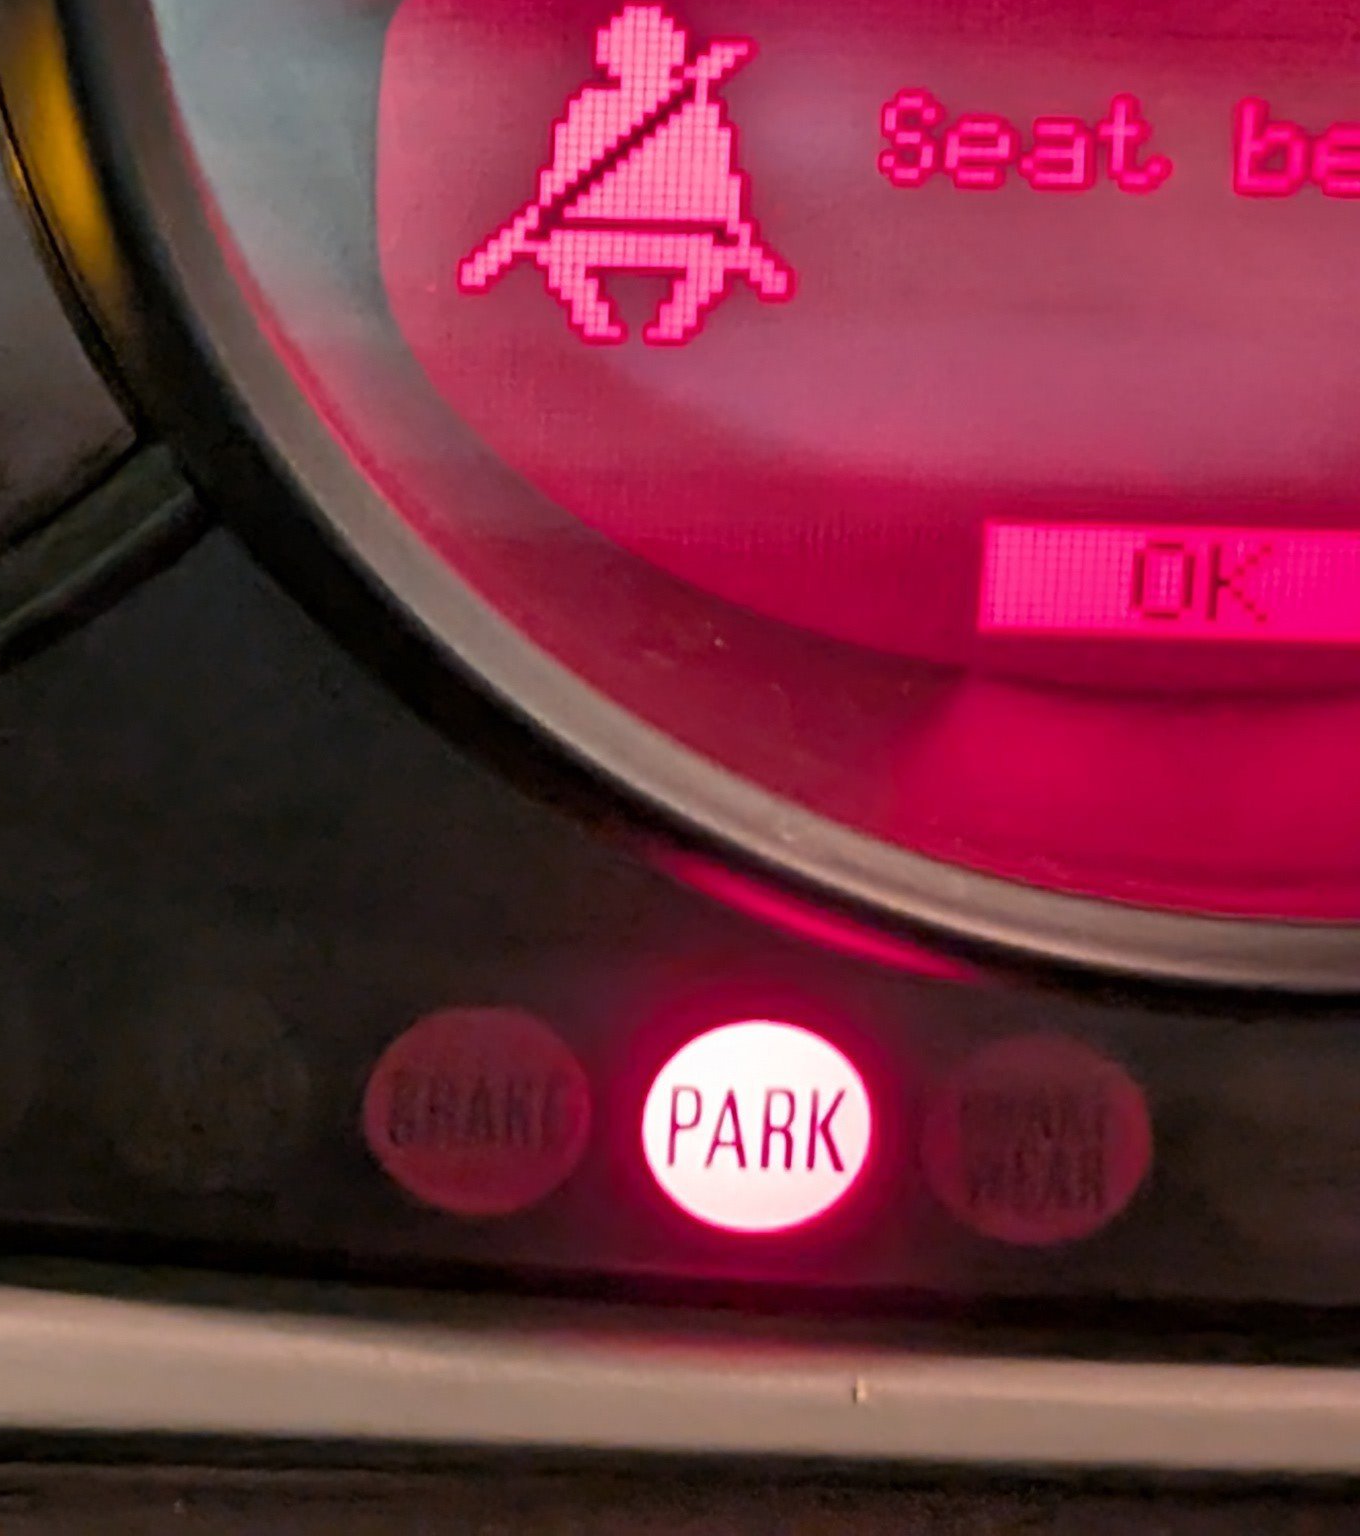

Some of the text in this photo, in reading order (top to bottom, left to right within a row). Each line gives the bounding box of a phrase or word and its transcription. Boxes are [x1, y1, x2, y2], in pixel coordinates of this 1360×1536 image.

[880, 90, 1170, 189] Seat
[1132, 540, 1272, 624] OK
[667, 1084, 847, 1173] PARK
